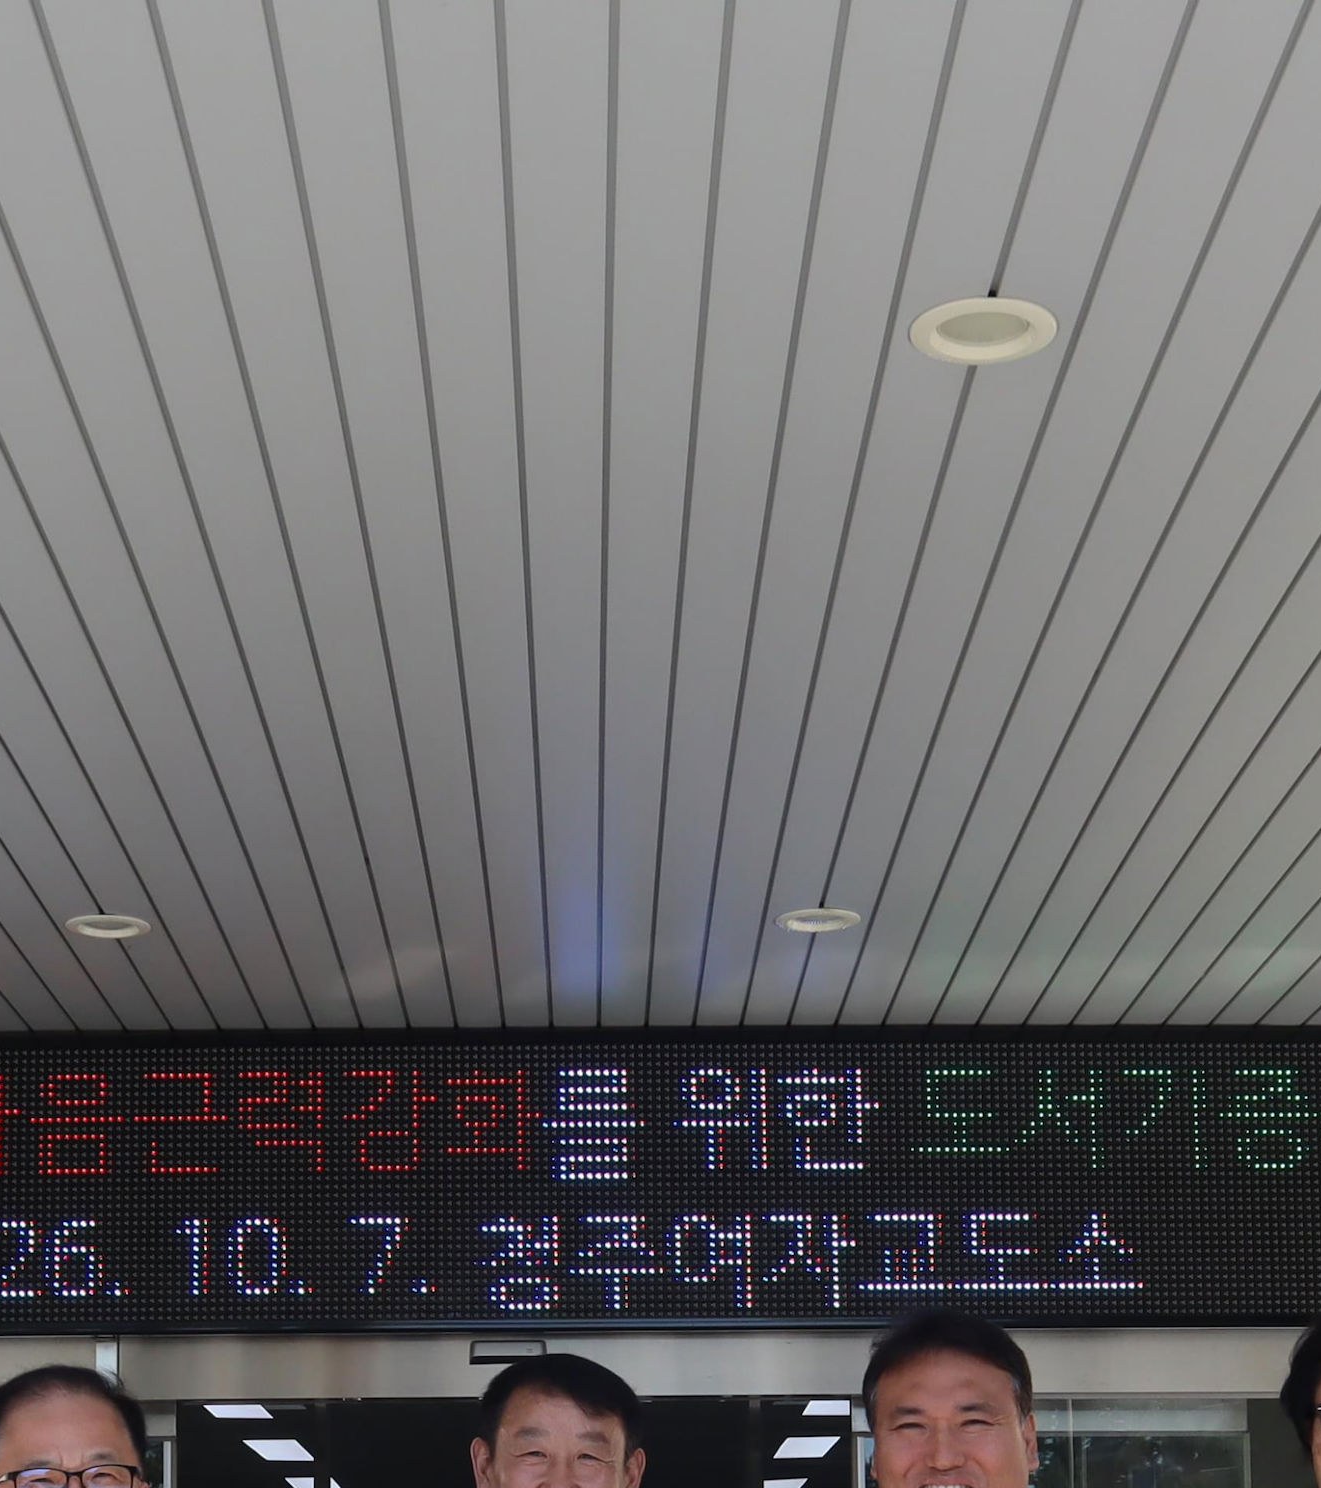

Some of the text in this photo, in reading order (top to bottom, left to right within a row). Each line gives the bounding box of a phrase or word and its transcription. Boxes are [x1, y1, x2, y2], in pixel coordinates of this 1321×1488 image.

[674, 1067, 880, 1170] 위한
[175, 1217, 314, 1296] 10.
[349, 1216, 437, 1295] 7.
[480, 1213, 1143, 1312] 청주여자교도소
